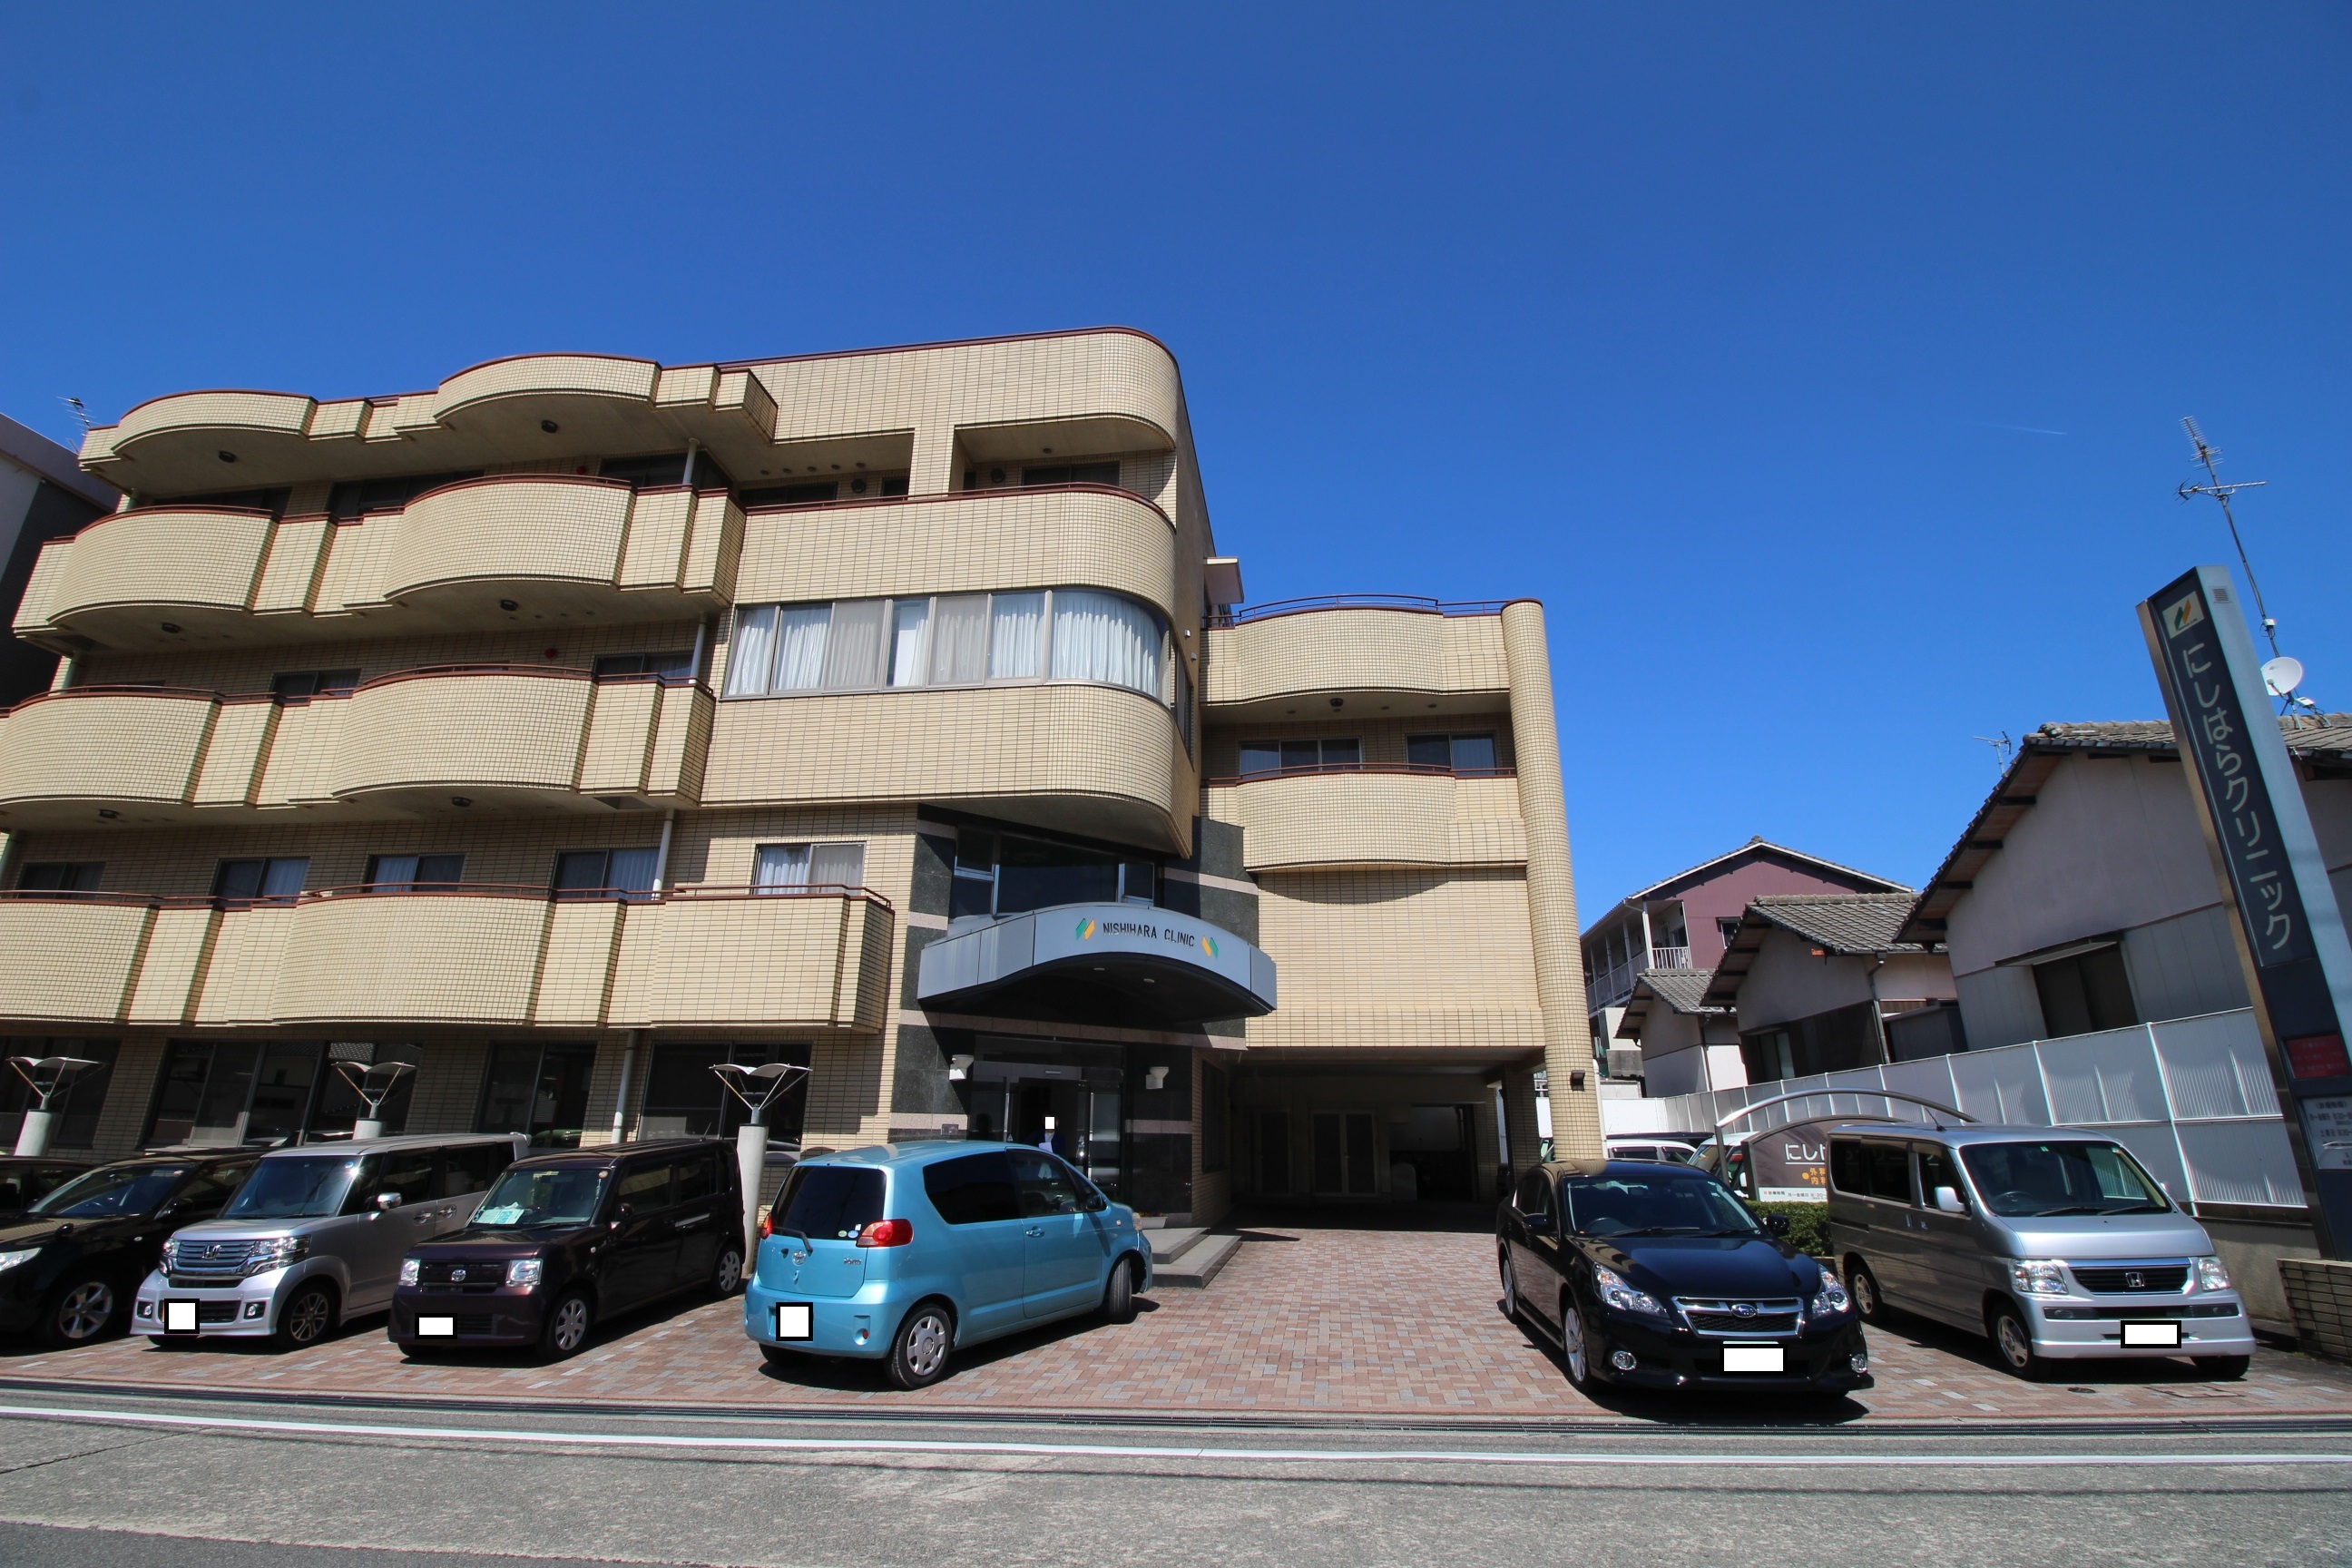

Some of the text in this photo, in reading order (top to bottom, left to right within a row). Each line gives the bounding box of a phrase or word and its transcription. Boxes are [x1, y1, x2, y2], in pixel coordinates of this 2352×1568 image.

[2182, 642, 2290, 949] にしはらクリニック
[1102, 922, 1195, 947] NISHIHARA CLINIC
